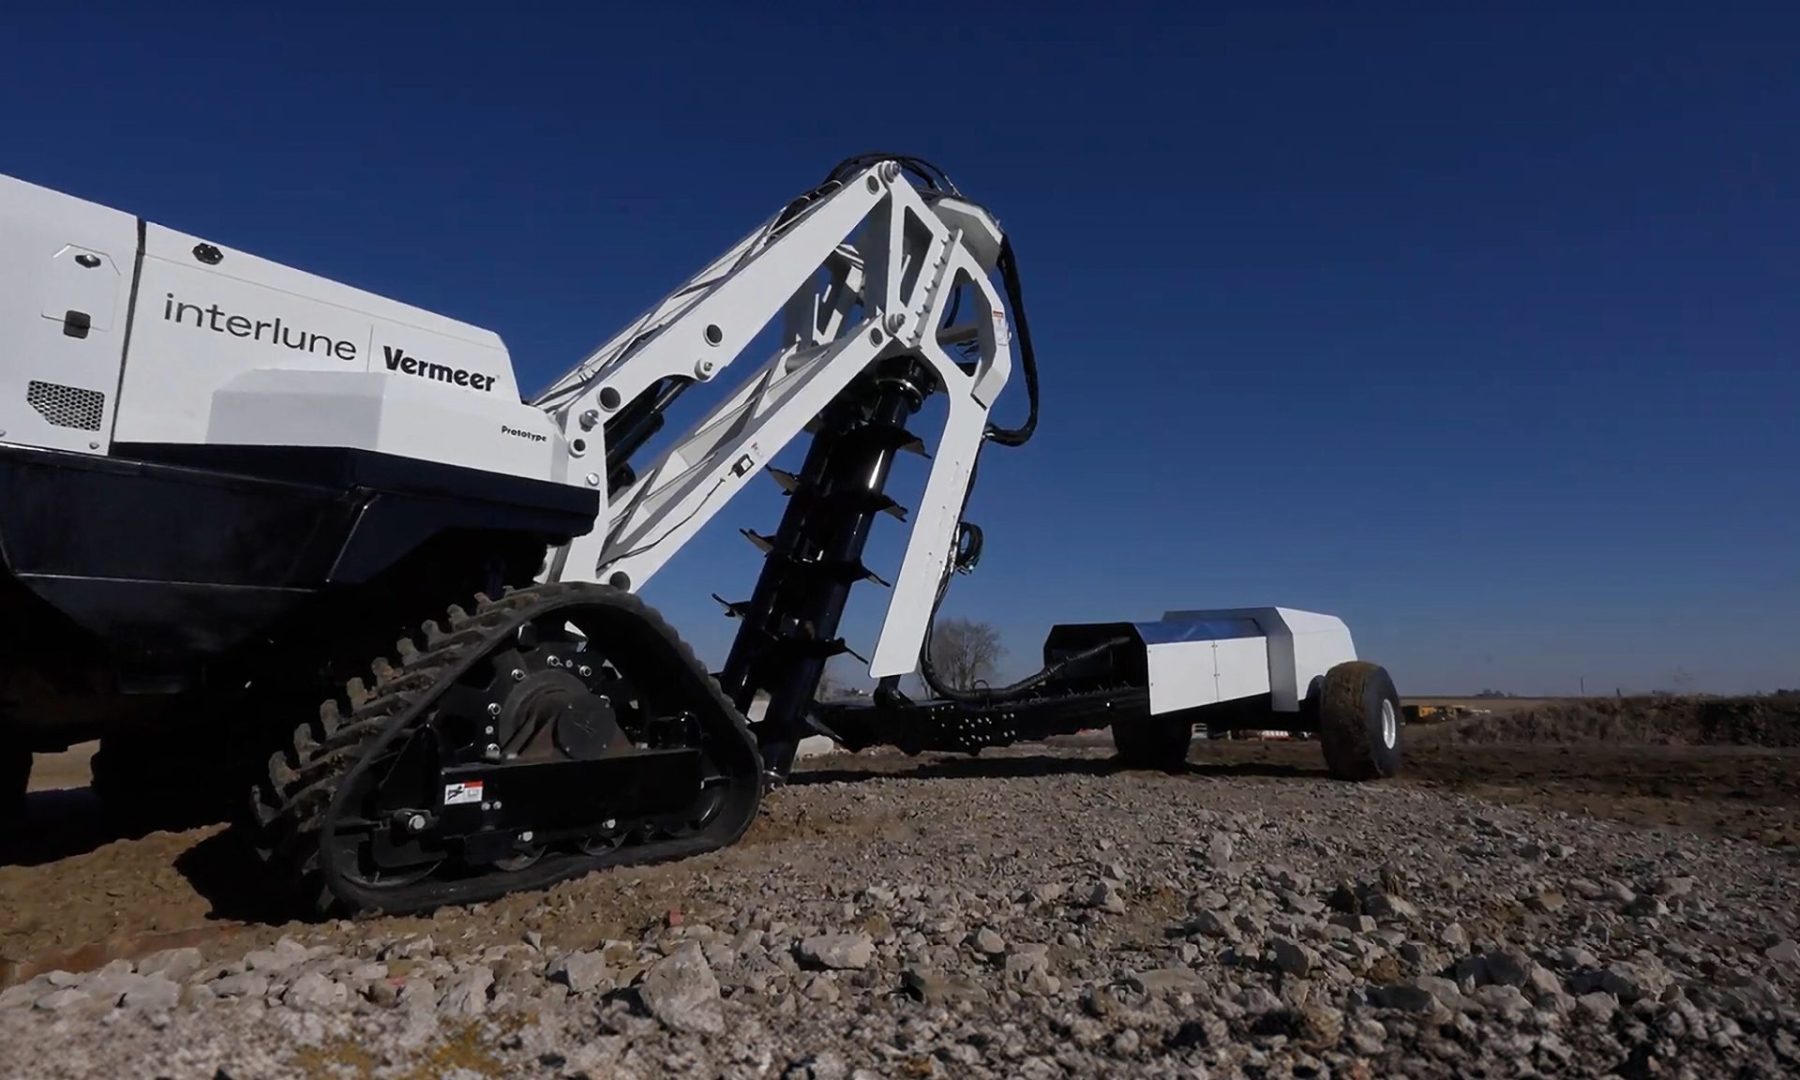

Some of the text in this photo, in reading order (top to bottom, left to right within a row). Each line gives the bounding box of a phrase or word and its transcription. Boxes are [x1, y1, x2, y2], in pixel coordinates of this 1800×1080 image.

[165, 293, 357, 361] interlune
[382, 345, 496, 392] Vermeer
[501, 425, 547, 442] Prototype
